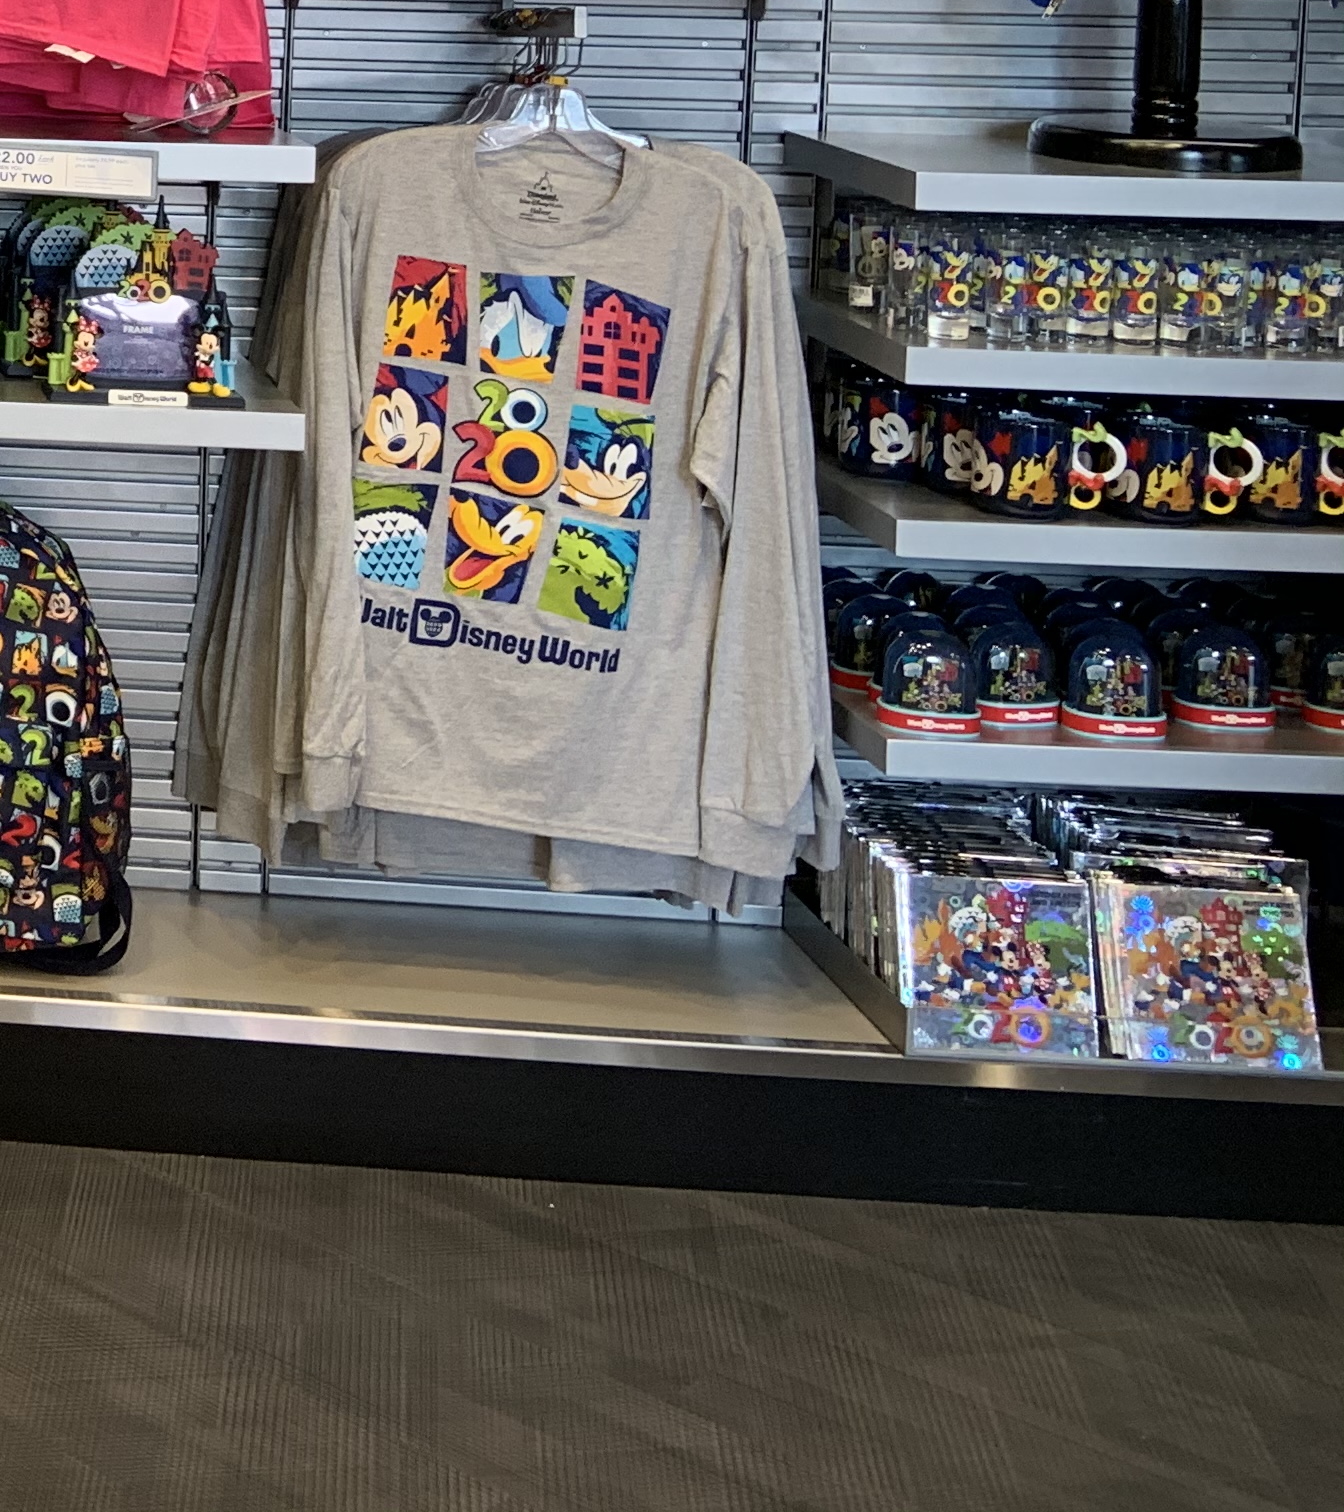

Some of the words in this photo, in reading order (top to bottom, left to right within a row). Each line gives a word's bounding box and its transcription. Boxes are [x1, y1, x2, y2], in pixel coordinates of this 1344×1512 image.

[21, 173, 53, 185] TWO
[123, 325, 154, 334] FRAME
[409, 598, 535, 664] Disney
[538, 634, 621, 673] World
